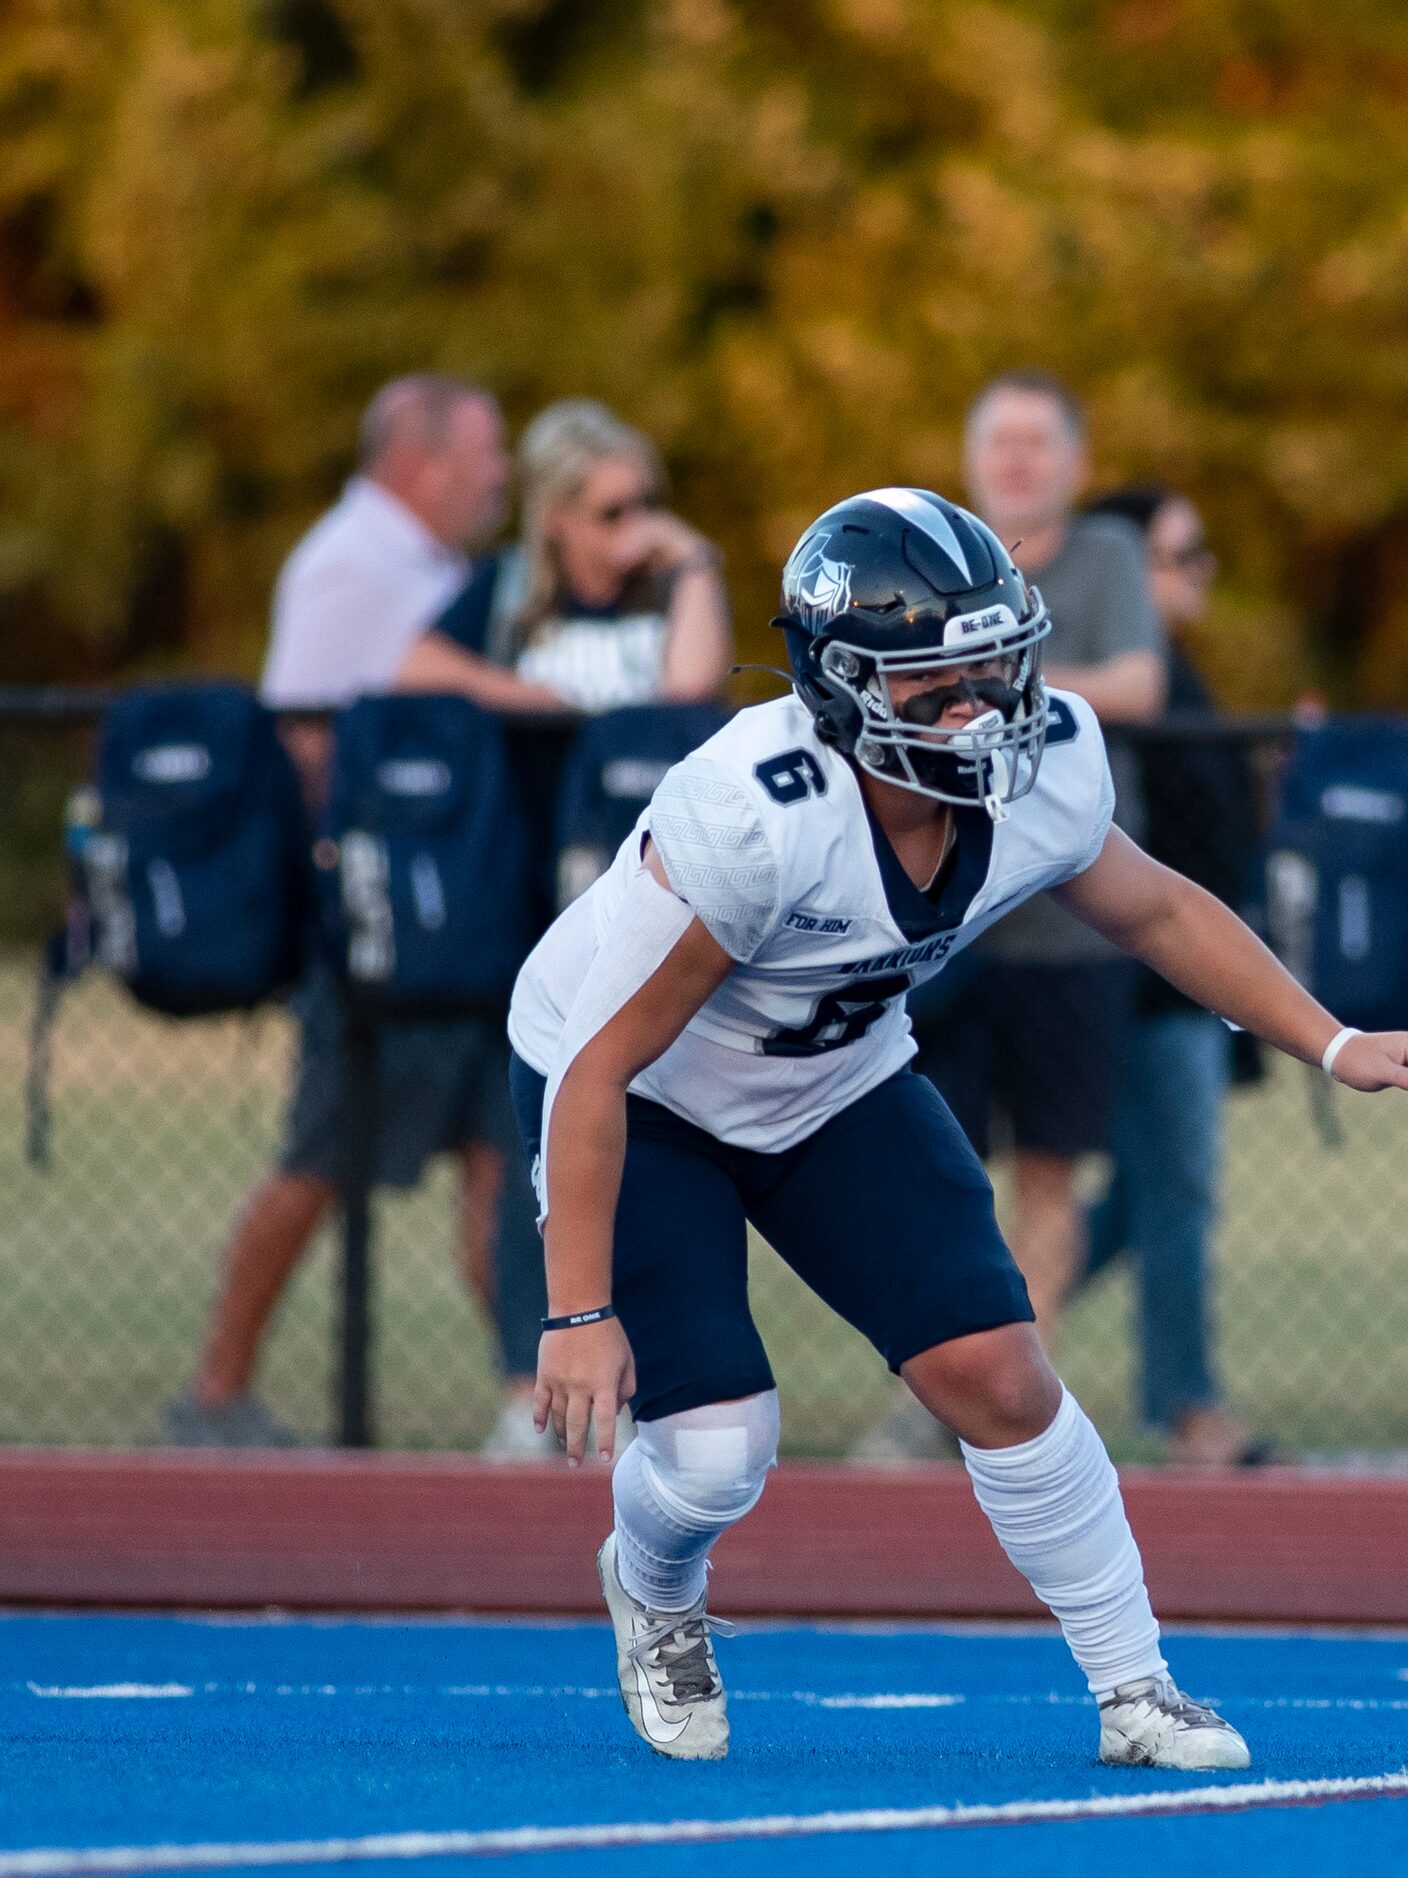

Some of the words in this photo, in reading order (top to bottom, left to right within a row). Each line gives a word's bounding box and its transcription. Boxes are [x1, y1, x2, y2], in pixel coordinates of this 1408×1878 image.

[960, 611, 1004, 634] BE-ONE
[752, 746, 829, 808] 6
[786, 914, 815, 931] FOR
[820, 919, 851, 933] HIM
